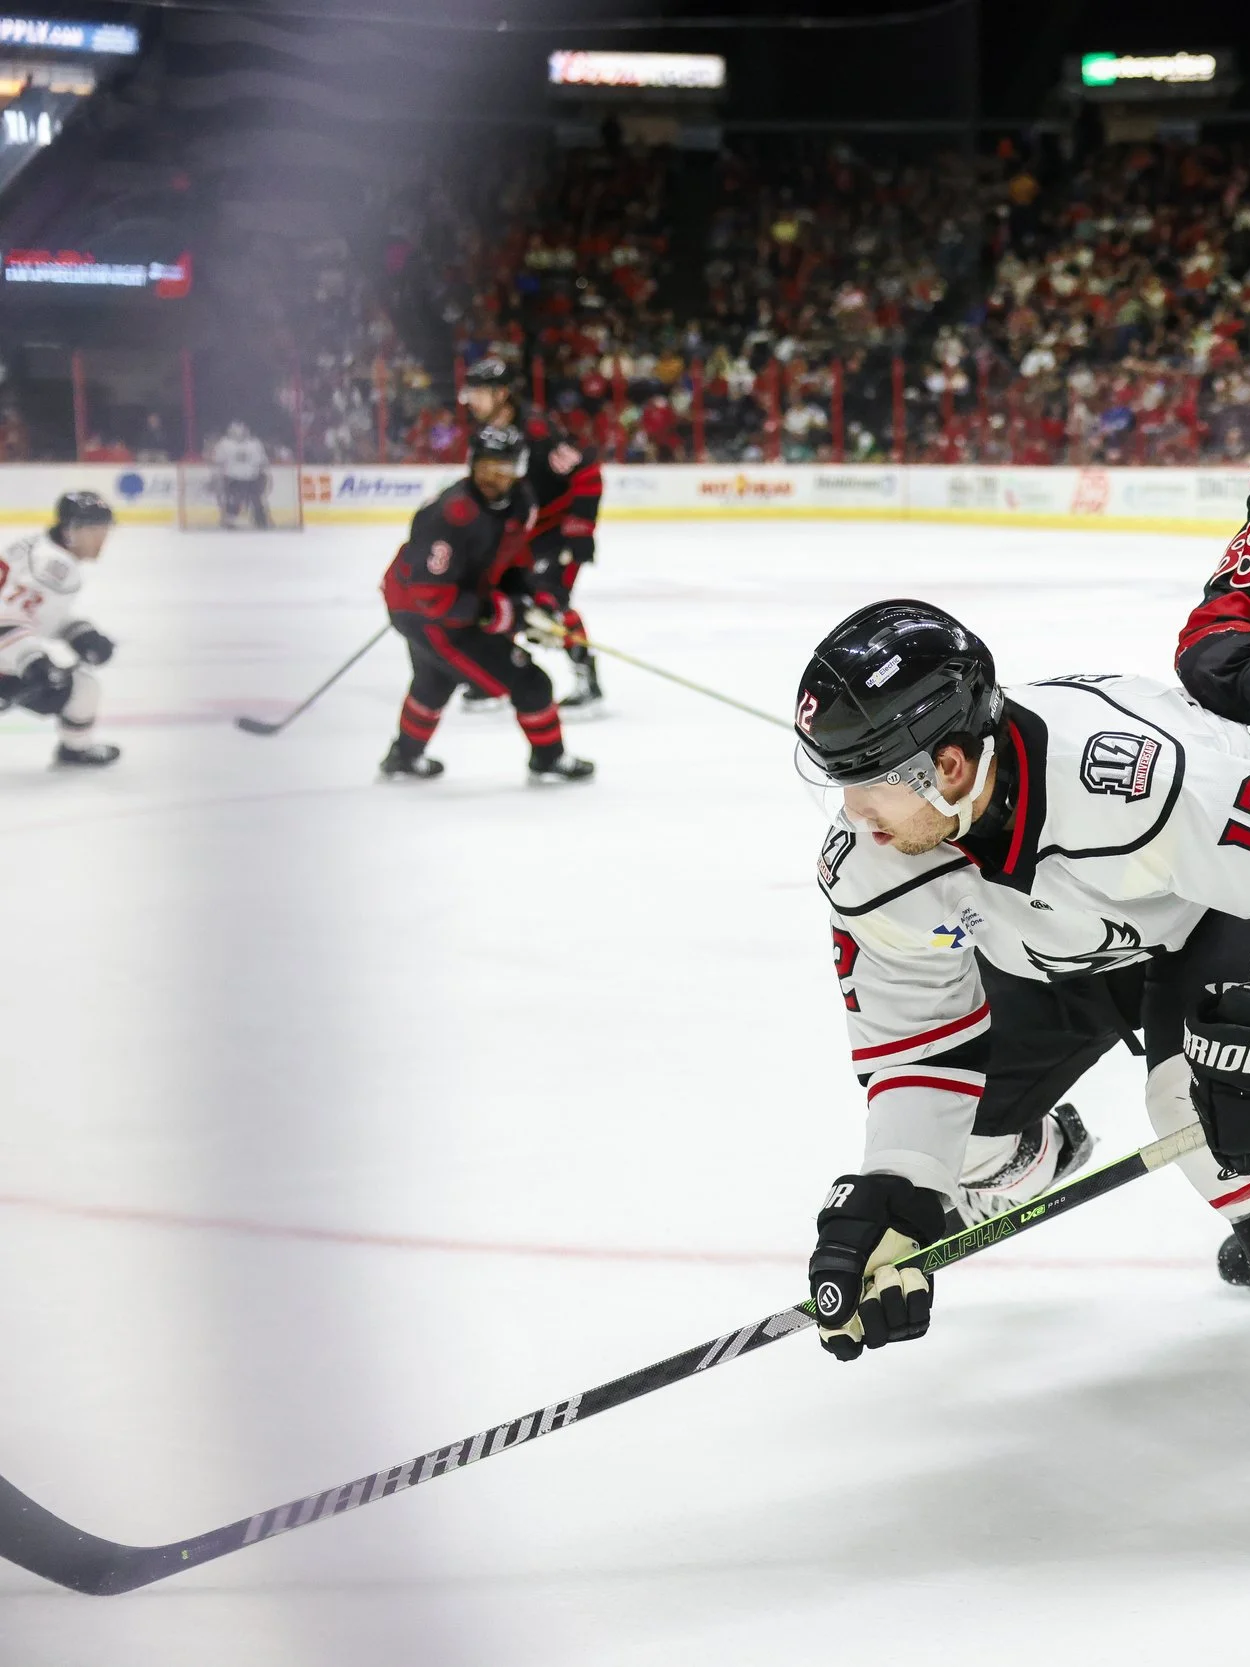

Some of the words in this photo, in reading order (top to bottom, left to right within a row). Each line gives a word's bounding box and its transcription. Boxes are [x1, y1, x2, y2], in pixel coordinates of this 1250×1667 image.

[426, 540, 453, 575] 3
[878, 657, 900, 676] Electric
[795, 688, 818, 734] 12
[1134, 740, 1156, 791] ANNIVERSARY
[922, 1216, 1017, 1273] ALPHA
[1048, 1196, 1066, 1209] PRO
[242, 1393, 583, 1544] WARRIOR
